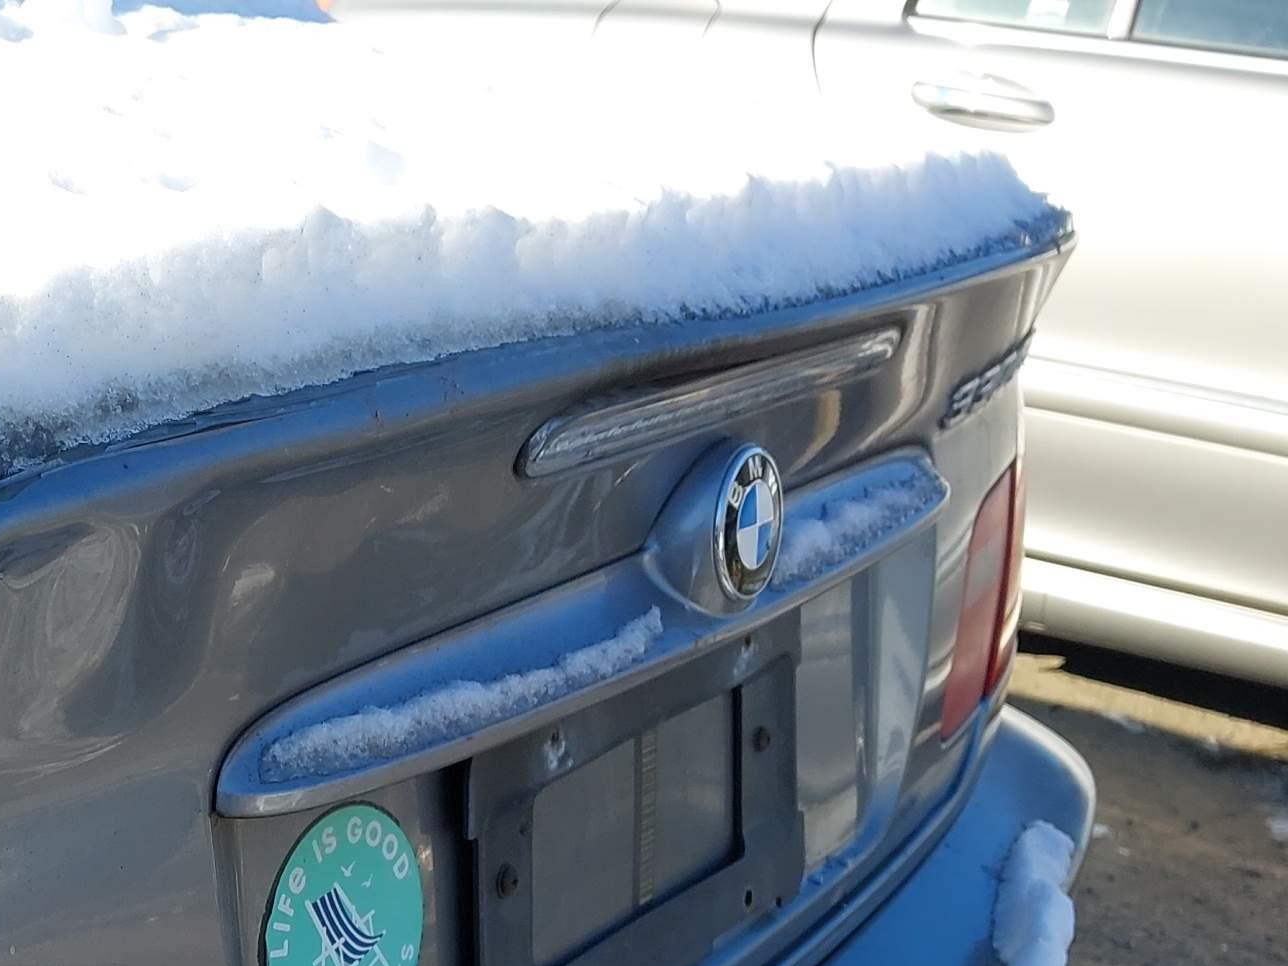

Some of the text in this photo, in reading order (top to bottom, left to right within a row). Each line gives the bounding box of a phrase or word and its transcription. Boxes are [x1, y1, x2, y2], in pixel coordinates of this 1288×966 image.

[727, 454, 778, 509] BMW
[312, 826, 337, 862] IS
[346, 816, 409, 880] GOOD
